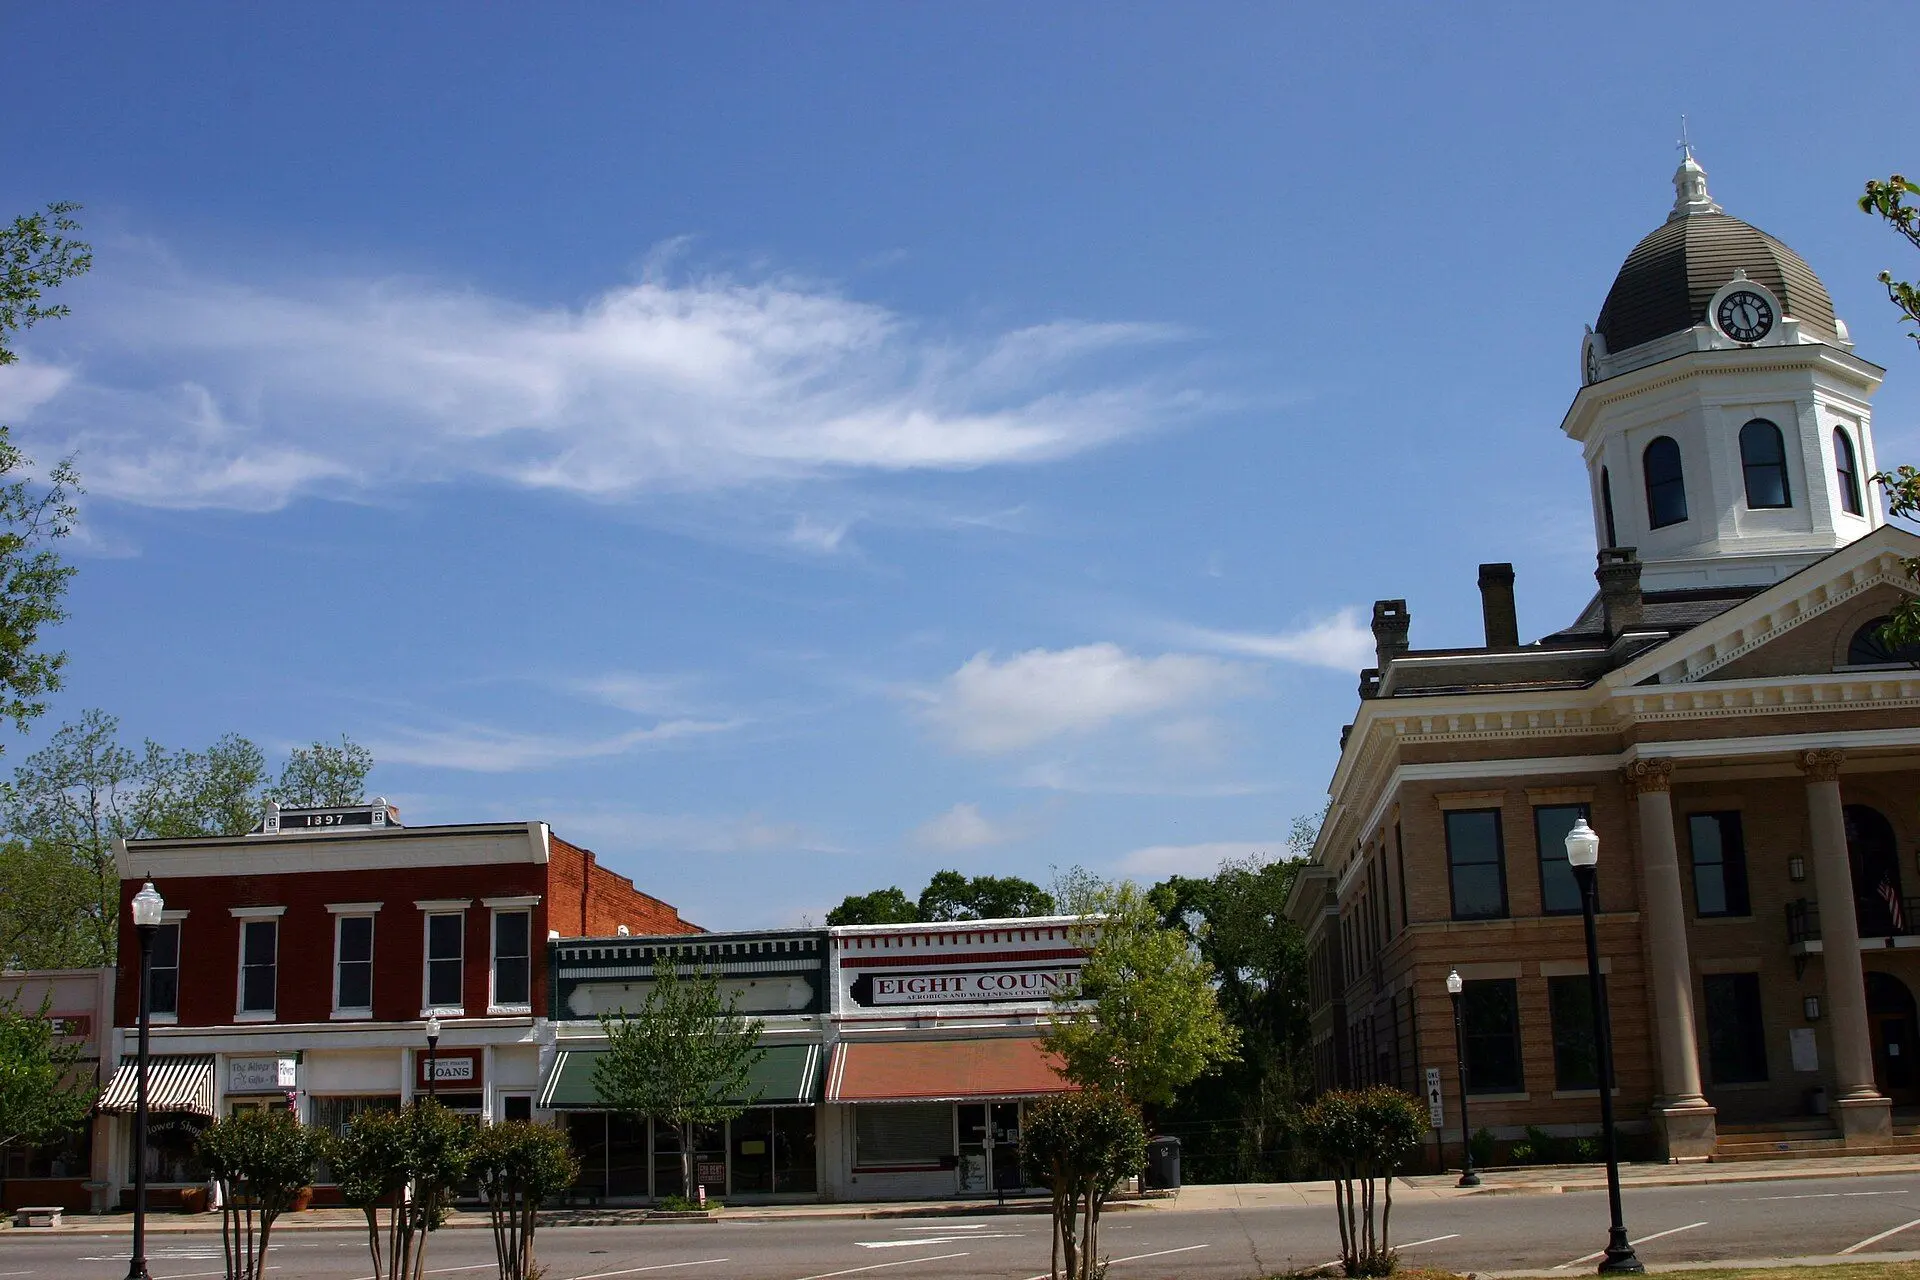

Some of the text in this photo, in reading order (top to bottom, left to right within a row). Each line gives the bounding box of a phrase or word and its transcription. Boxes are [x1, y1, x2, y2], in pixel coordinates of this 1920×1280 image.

[307, 814, 343, 826] 1897
[878, 977, 967, 994] EIGHT
[969, 990, 1013, 998] WELLNESS
[1014, 988, 1048, 996] CENTER
[145, 1120, 176, 1135] lower
